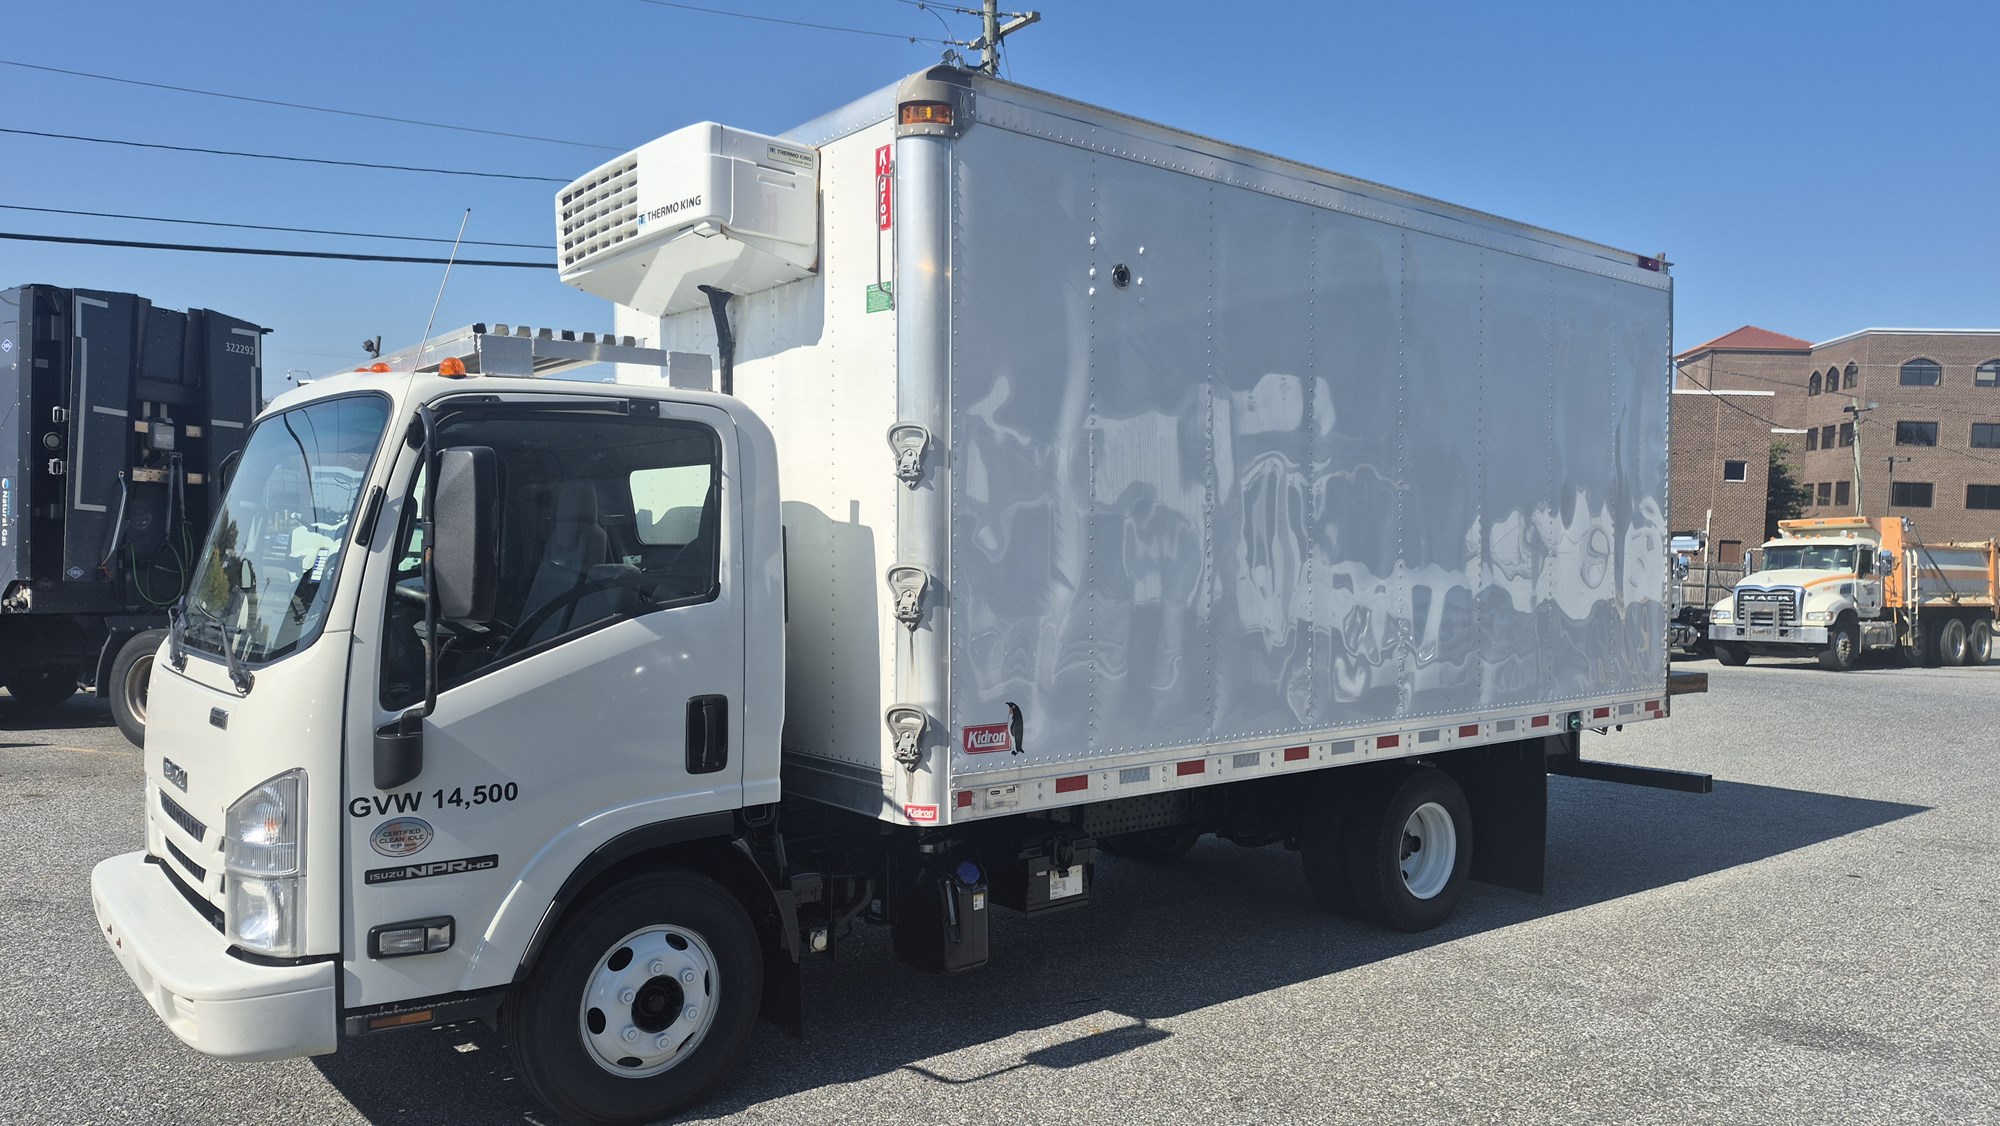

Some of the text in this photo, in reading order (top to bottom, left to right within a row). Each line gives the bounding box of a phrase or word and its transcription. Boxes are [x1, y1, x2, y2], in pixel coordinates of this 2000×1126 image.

[777, 148, 799, 159] THERMO
[800, 154, 812, 162] KING
[879, 147, 888, 227] Kidron
[647, 194, 702, 222] THERMO KING
[225, 341, 255, 356] 322292
[967, 728, 1007, 750] Kidron
[349, 782, 519, 817] GVW 14,500
[906, 806, 935, 819] Kidron
[378, 834, 425, 845] CLEAN IDLE
[382, 828, 421, 838] CERTIFIED
[369, 860, 494, 881] ISUZU NPR HD
